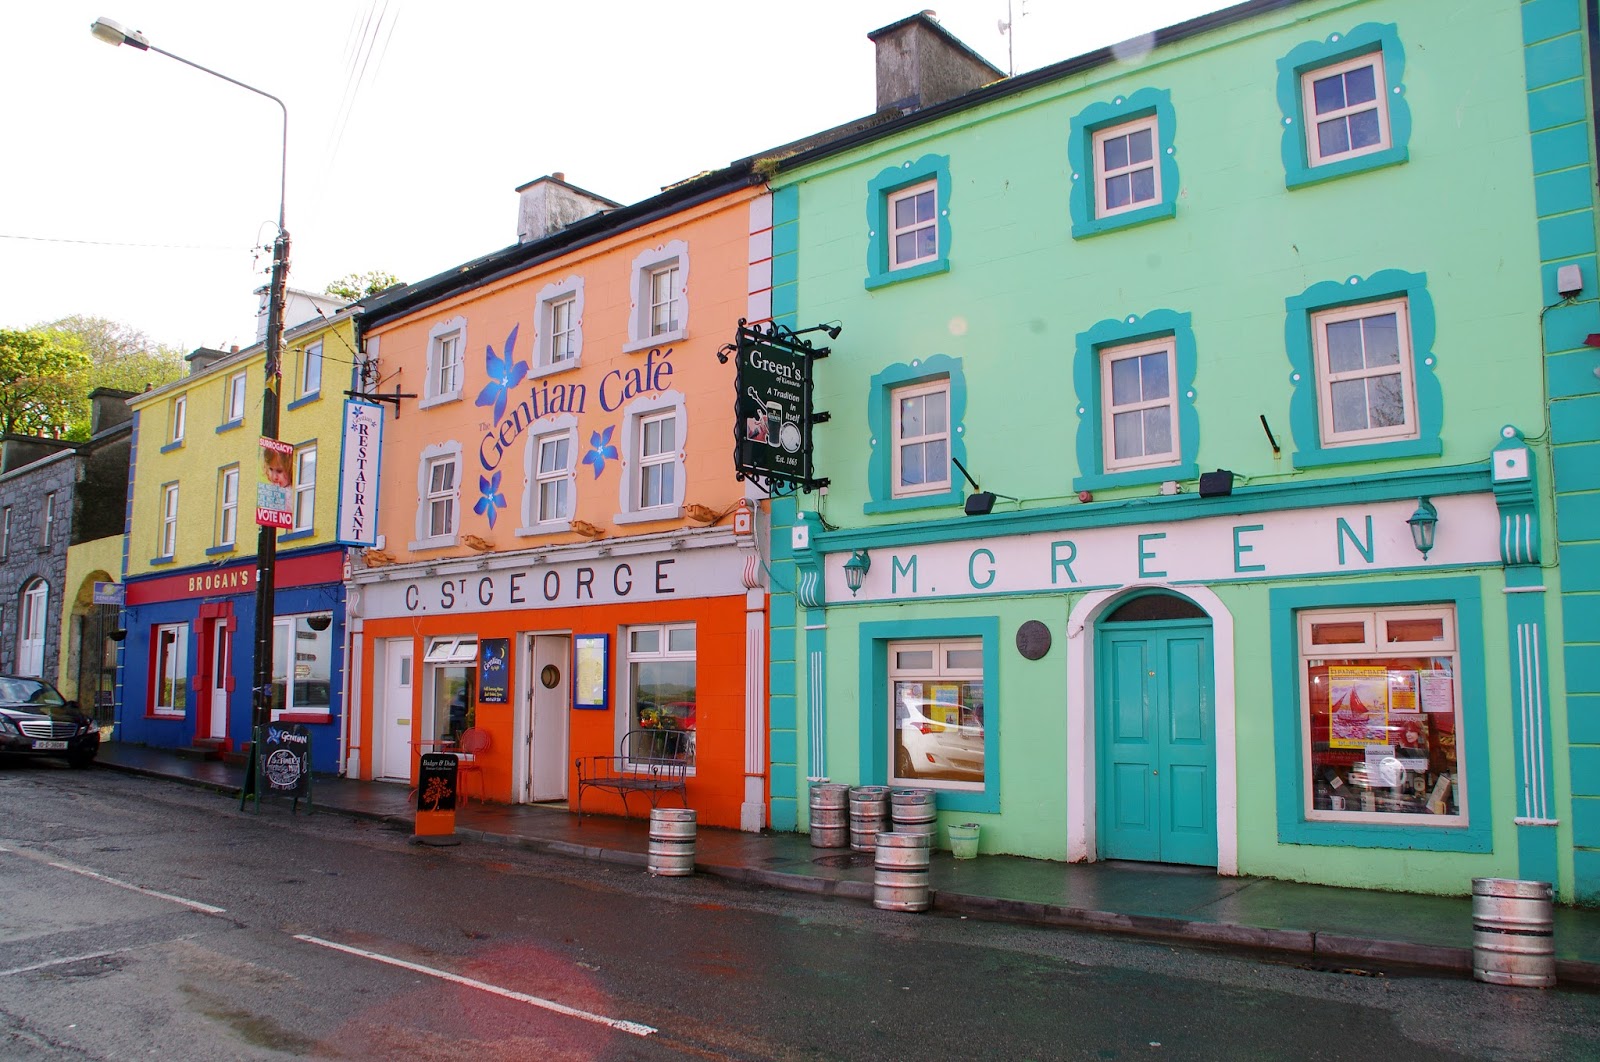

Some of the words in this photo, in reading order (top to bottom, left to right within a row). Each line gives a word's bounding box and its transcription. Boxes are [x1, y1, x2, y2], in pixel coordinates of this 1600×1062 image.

[750, 350, 802, 381] Green's
[767, 387, 772, 395] A
[773, 388, 800, 403] Tradition
[479, 380, 587, 471] Gentian
[599, 348, 674, 413] Café
[479, 422, 490, 432] The
[259, 438, 293, 454] SURROGACY?
[352, 423, 369, 540] RESTAURANT
[257, 508, 278, 523] VOTE
[279, 512, 292, 525] NO
[892, 554, 936, 593] M.
[968, 515, 1373, 589] GREEN
[189, 570, 248, 592] BROGAN'S
[405, 584, 426, 611] C.
[478, 559, 675, 606] GEORGE
